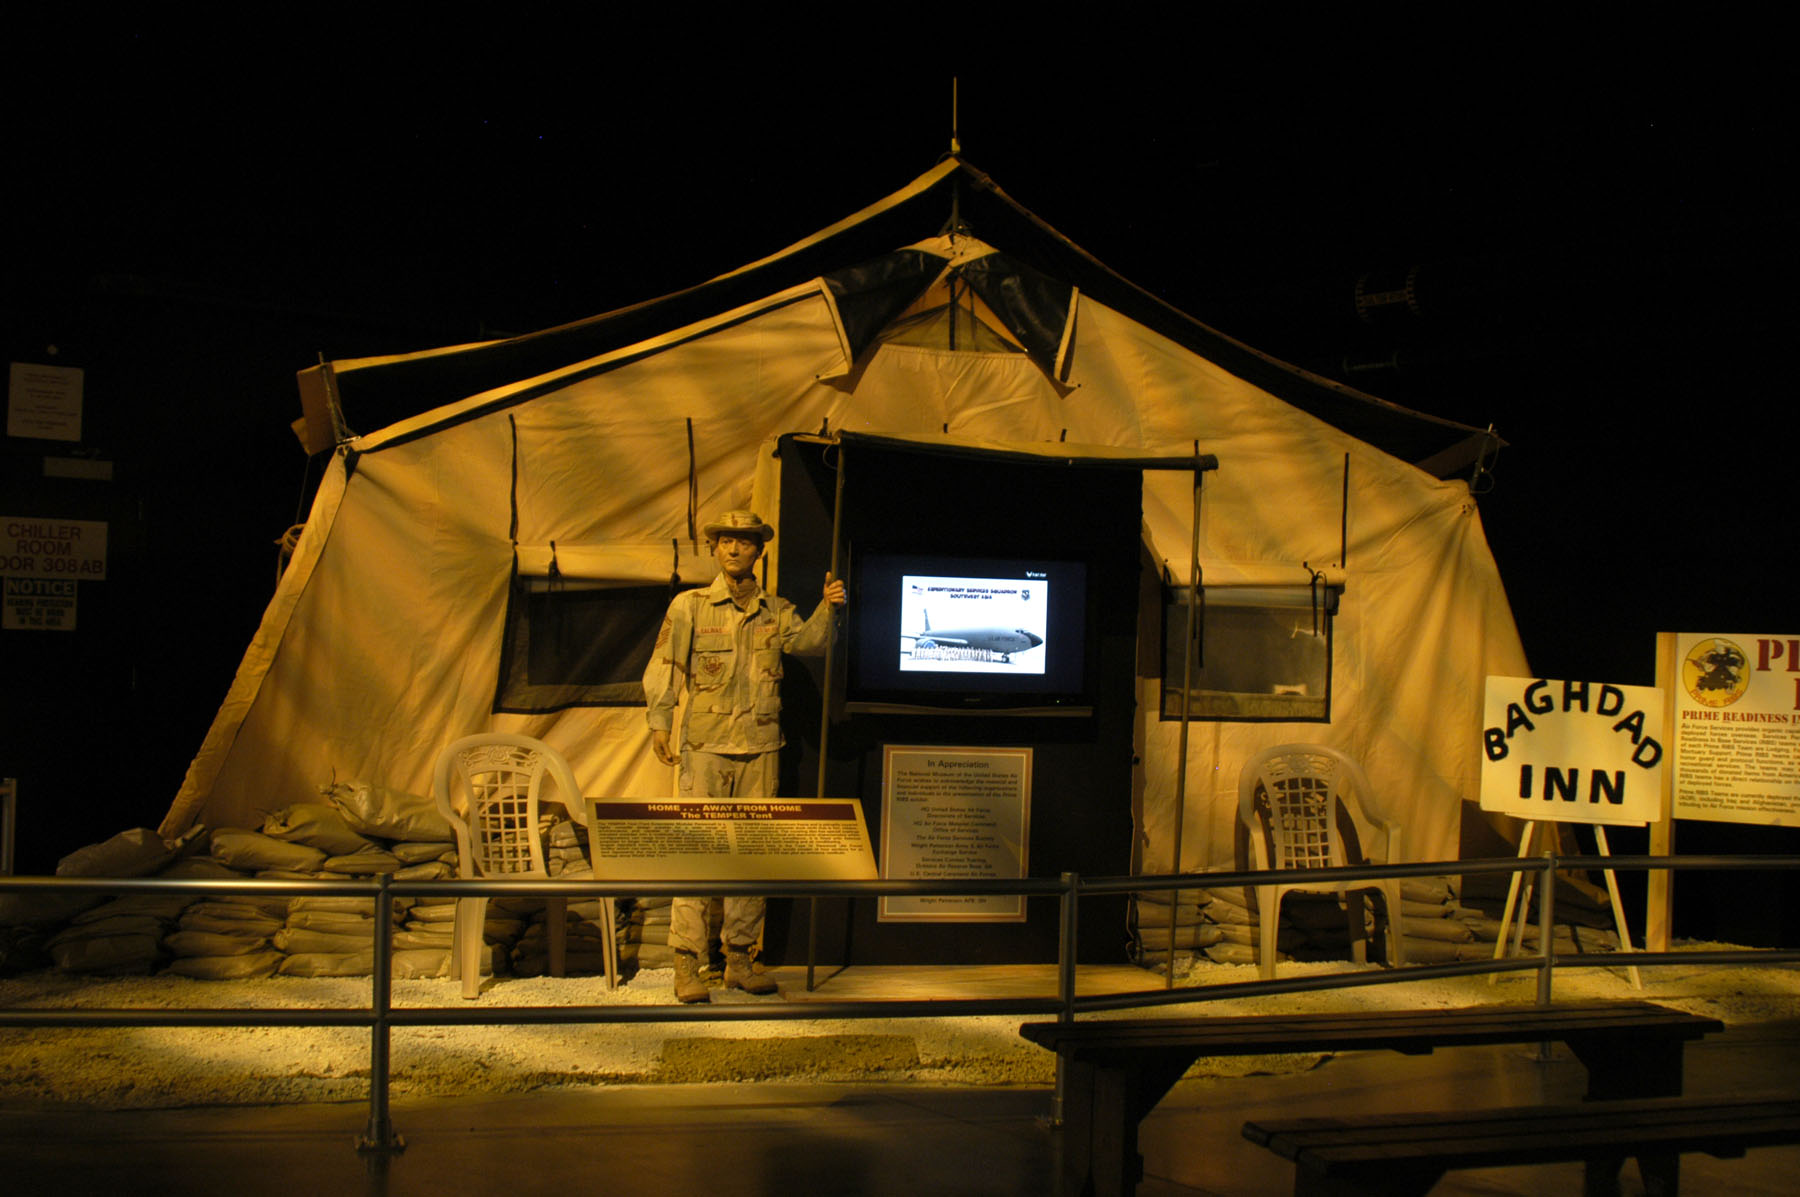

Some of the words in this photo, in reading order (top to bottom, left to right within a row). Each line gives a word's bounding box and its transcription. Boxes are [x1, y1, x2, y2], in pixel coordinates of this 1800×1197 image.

[8, 523, 81, 540] CHILLER
[17, 540, 71, 556] ROOM
[8, 580, 74, 594] NOTICE
[1682, 710, 1720, 720] PRIME
[1723, 712, 1788, 723] READINESS
[1484, 680, 1663, 770] BAGHDAD
[938, 760, 989, 769] Appreciation
[1520, 764, 1626, 804] INN
